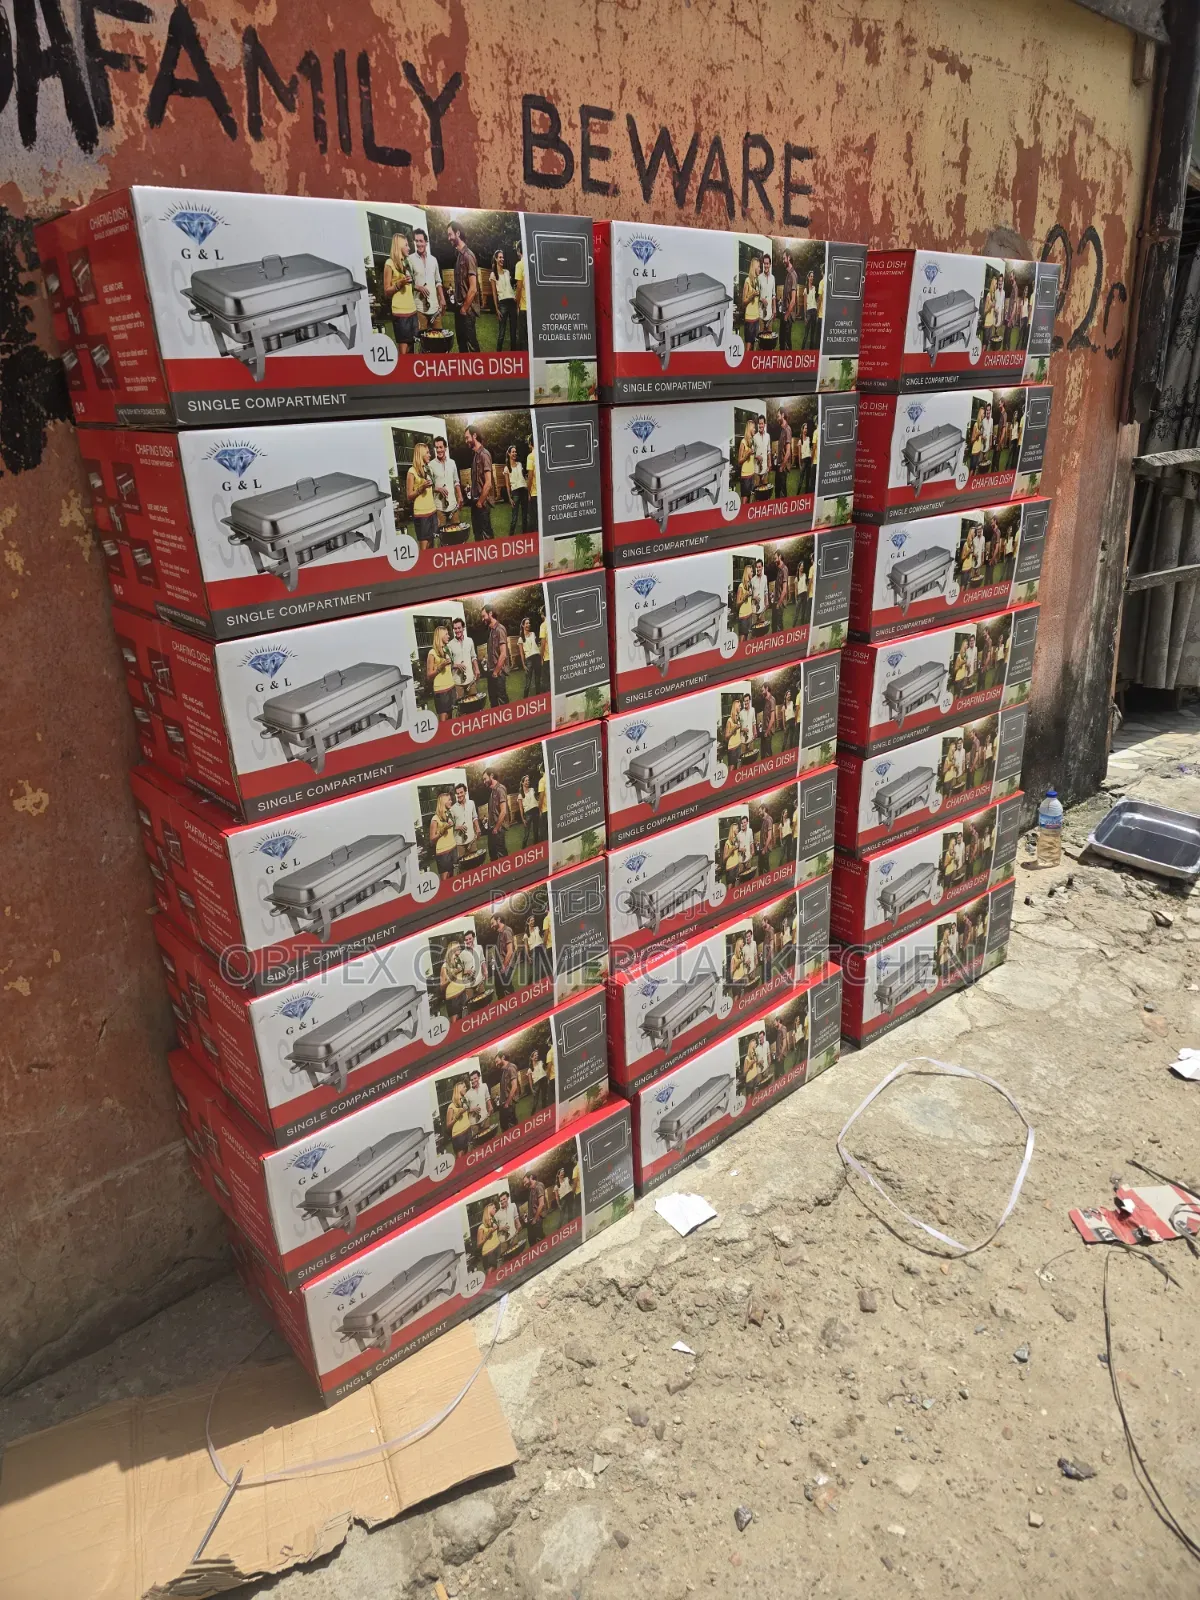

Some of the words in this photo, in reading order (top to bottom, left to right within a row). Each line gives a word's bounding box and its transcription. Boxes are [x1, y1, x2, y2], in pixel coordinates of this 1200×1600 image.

[81, 0, 462, 177] FAMILY
[522, 94, 813, 228] BEWARE
[886, 260, 907, 269] DISH
[542, 322, 571, 330] STORAGE
[550, 312, 580, 320] COMPACT
[539, 332, 570, 340] FOLDABLE
[572, 332, 592, 340] STAND
[370, 346, 393, 362] 12L
[728, 344, 741, 356] 12L
[413, 358, 484, 377] CHAFING
[488, 357, 523, 374] DISH
[752, 355, 792, 369] CHAFING
[795, 354, 815, 368] DISH
[622, 383, 652, 392] SINGLE
[654, 380, 712, 390] COMPARTMENT
[187, 398, 240, 411] SINGLE
[245, 393, 346, 408] COMPARTMENT
[550, 501, 578, 511] STORAGE
[558, 491, 586, 501] COMPACT
[725, 499, 738, 511] 12L
[548, 510, 577, 521] FOLDABLE
[578, 507, 596, 516] STAND
[748, 501, 788, 519] CHAFING
[790, 498, 810, 512] DISH
[393, 545, 414, 560] 12L
[433, 544, 497, 568] CHAFING
[502, 538, 533, 557] DISH
[622, 545, 651, 557] SINGLE
[653, 535, 709, 552] COMPARTMENT
[226, 608, 275, 625] SINGLE
[279, 591, 371, 616] COMPARTMENT
[723, 639, 735, 650] 12L
[745, 635, 784, 655] CHAFING
[786, 628, 806, 644] DISH
[625, 690, 652, 703] SINGLE
[654, 674, 708, 695] COMPARTMENT
[414, 718, 434, 733] 12L
[451, 708, 512, 736] CHAFING
[516, 698, 545, 718] DISH
[714, 769, 726, 781] 12L
[735, 760, 774, 782] CHAFING
[776, 751, 796, 768] DISH
[258, 791, 303, 811] SINGLE
[307, 764, 393, 797] COMPARTMENT
[617, 826, 644, 842] SINGLE
[646, 805, 699, 830] COMPARTMENT
[452, 859, 511, 892] CHAFING
[515, 846, 543, 868] DISH
[417, 879, 436, 894] 12L
[734, 875, 771, 899] CHAFING
[773, 864, 792, 882] DISH
[265, 961, 309, 984] SINGLE
[312, 925, 396, 965] COMPARTMENT
[461, 998, 517, 1033] CHAFING
[521, 981, 548, 1005] DISH
[428, 1023, 446, 1038] 12L
[287, 1110, 327, 1136] SINGLE
[330, 1070, 408, 1114] COMPARTMENT
[466, 1130, 520, 1168] CHAFING
[524, 1112, 551, 1136] DISH
[434, 1160, 452, 1176] 12L
[298, 1253, 337, 1280] SINGLE
[340, 1207, 415, 1256] COMPARTMENT
[496, 1242, 548, 1280] CHAFING
[551, 1222, 577, 1246] DISH
[465, 1276, 481, 1291] 12L
[336, 1369, 373, 1396] SINGLE
[376, 1321, 447, 1371] COMPARTMENT
